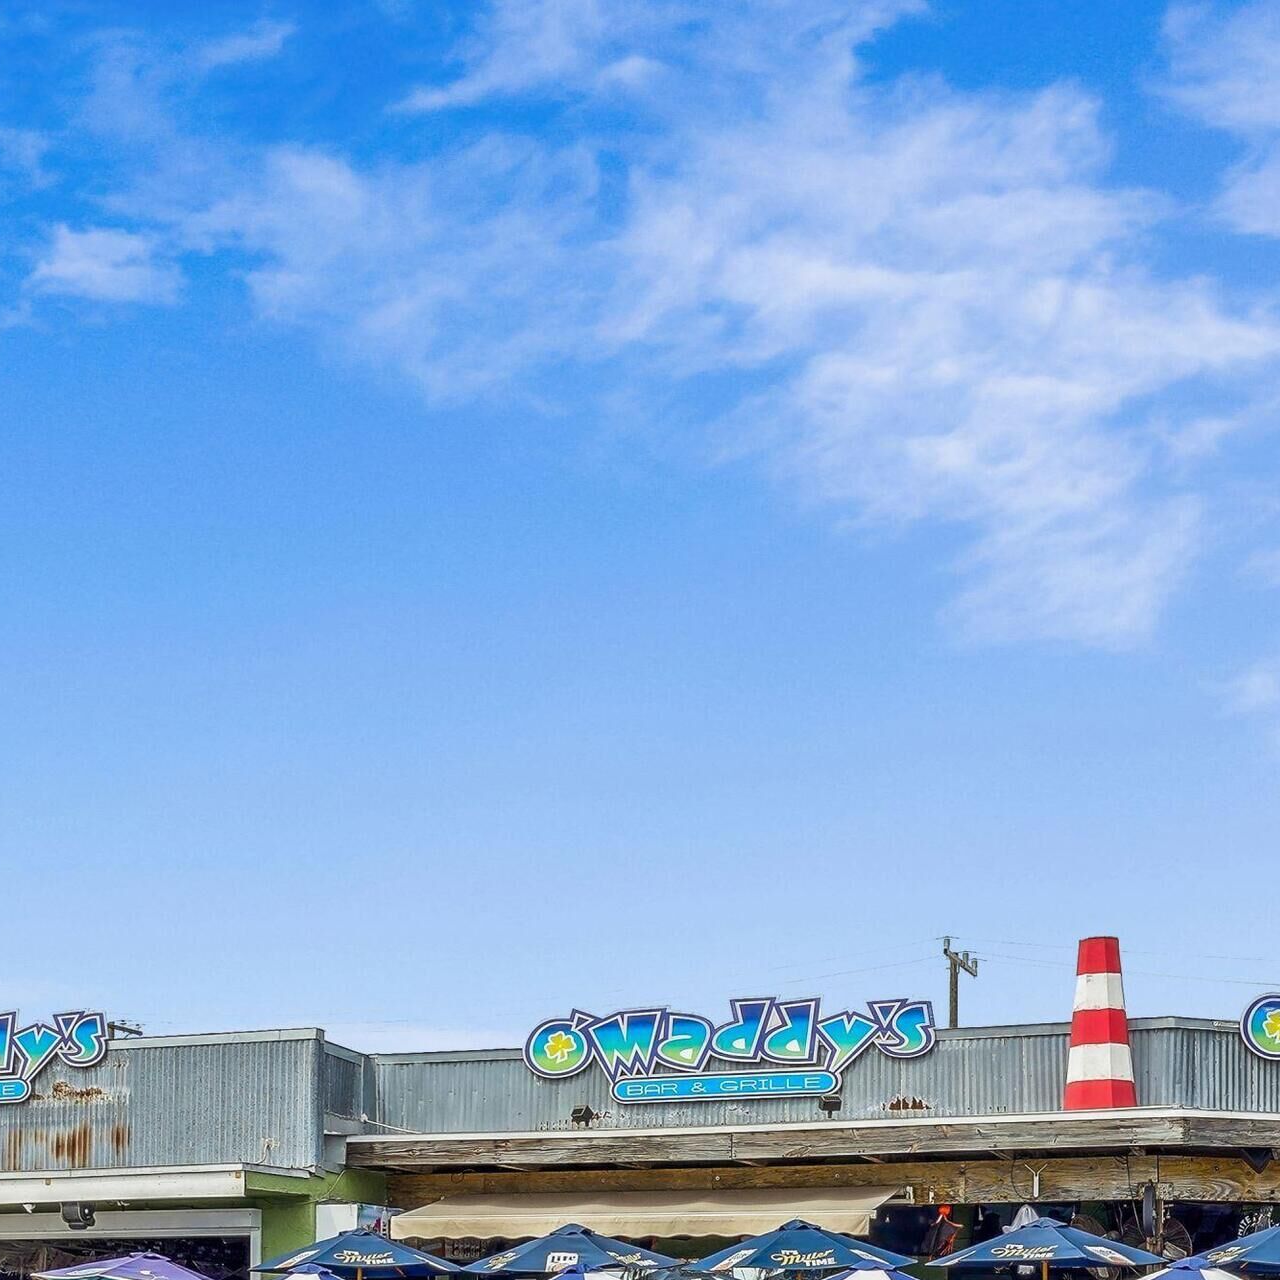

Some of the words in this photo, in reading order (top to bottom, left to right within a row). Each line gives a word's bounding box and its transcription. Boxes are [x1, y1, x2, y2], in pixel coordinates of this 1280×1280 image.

[524, 997, 935, 1081] O'Maddy's
[626, 1082, 678, 1096] BAR
[691, 1081, 707, 1093] &
[719, 1076, 823, 1092] GRILLE
[333, 1250, 393, 1264] Miller
[770, 1249, 835, 1266] Miller
[803, 1257, 838, 1267] TIME
